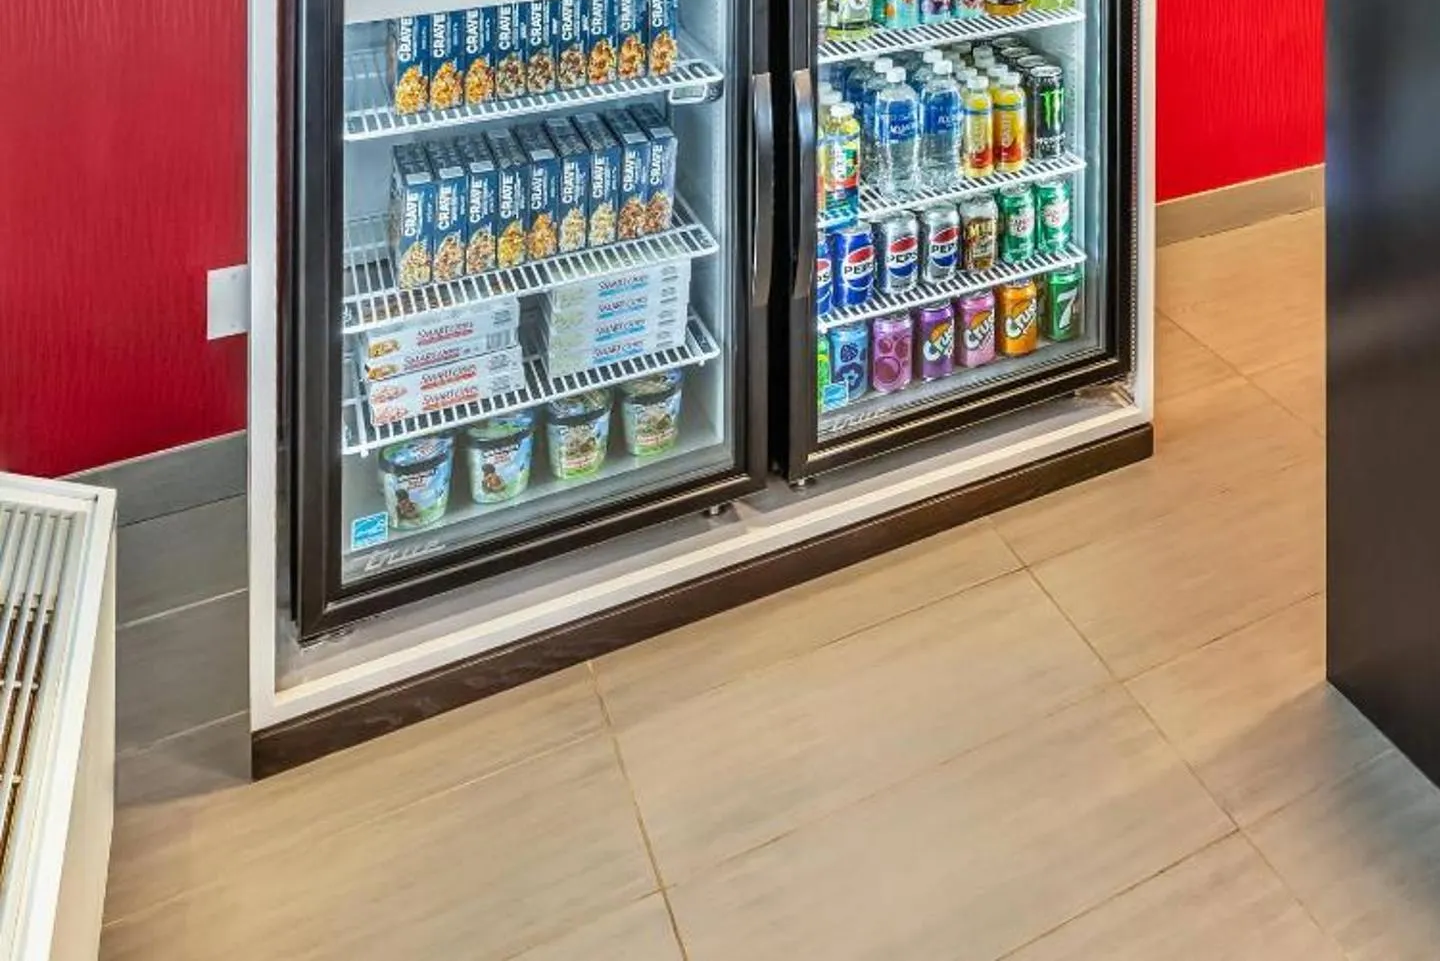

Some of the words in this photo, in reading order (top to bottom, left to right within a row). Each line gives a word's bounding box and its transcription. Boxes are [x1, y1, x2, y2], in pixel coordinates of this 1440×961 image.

[844, 261, 874, 275] PEPS
[889, 251, 918, 263] PEPS
[932, 242, 955, 254] PEP
[963, 308, 995, 350] Crus
[1005, 296, 1037, 339] Crus
[1057, 287, 1078, 330] 7
[923, 320, 955, 362] Crus
